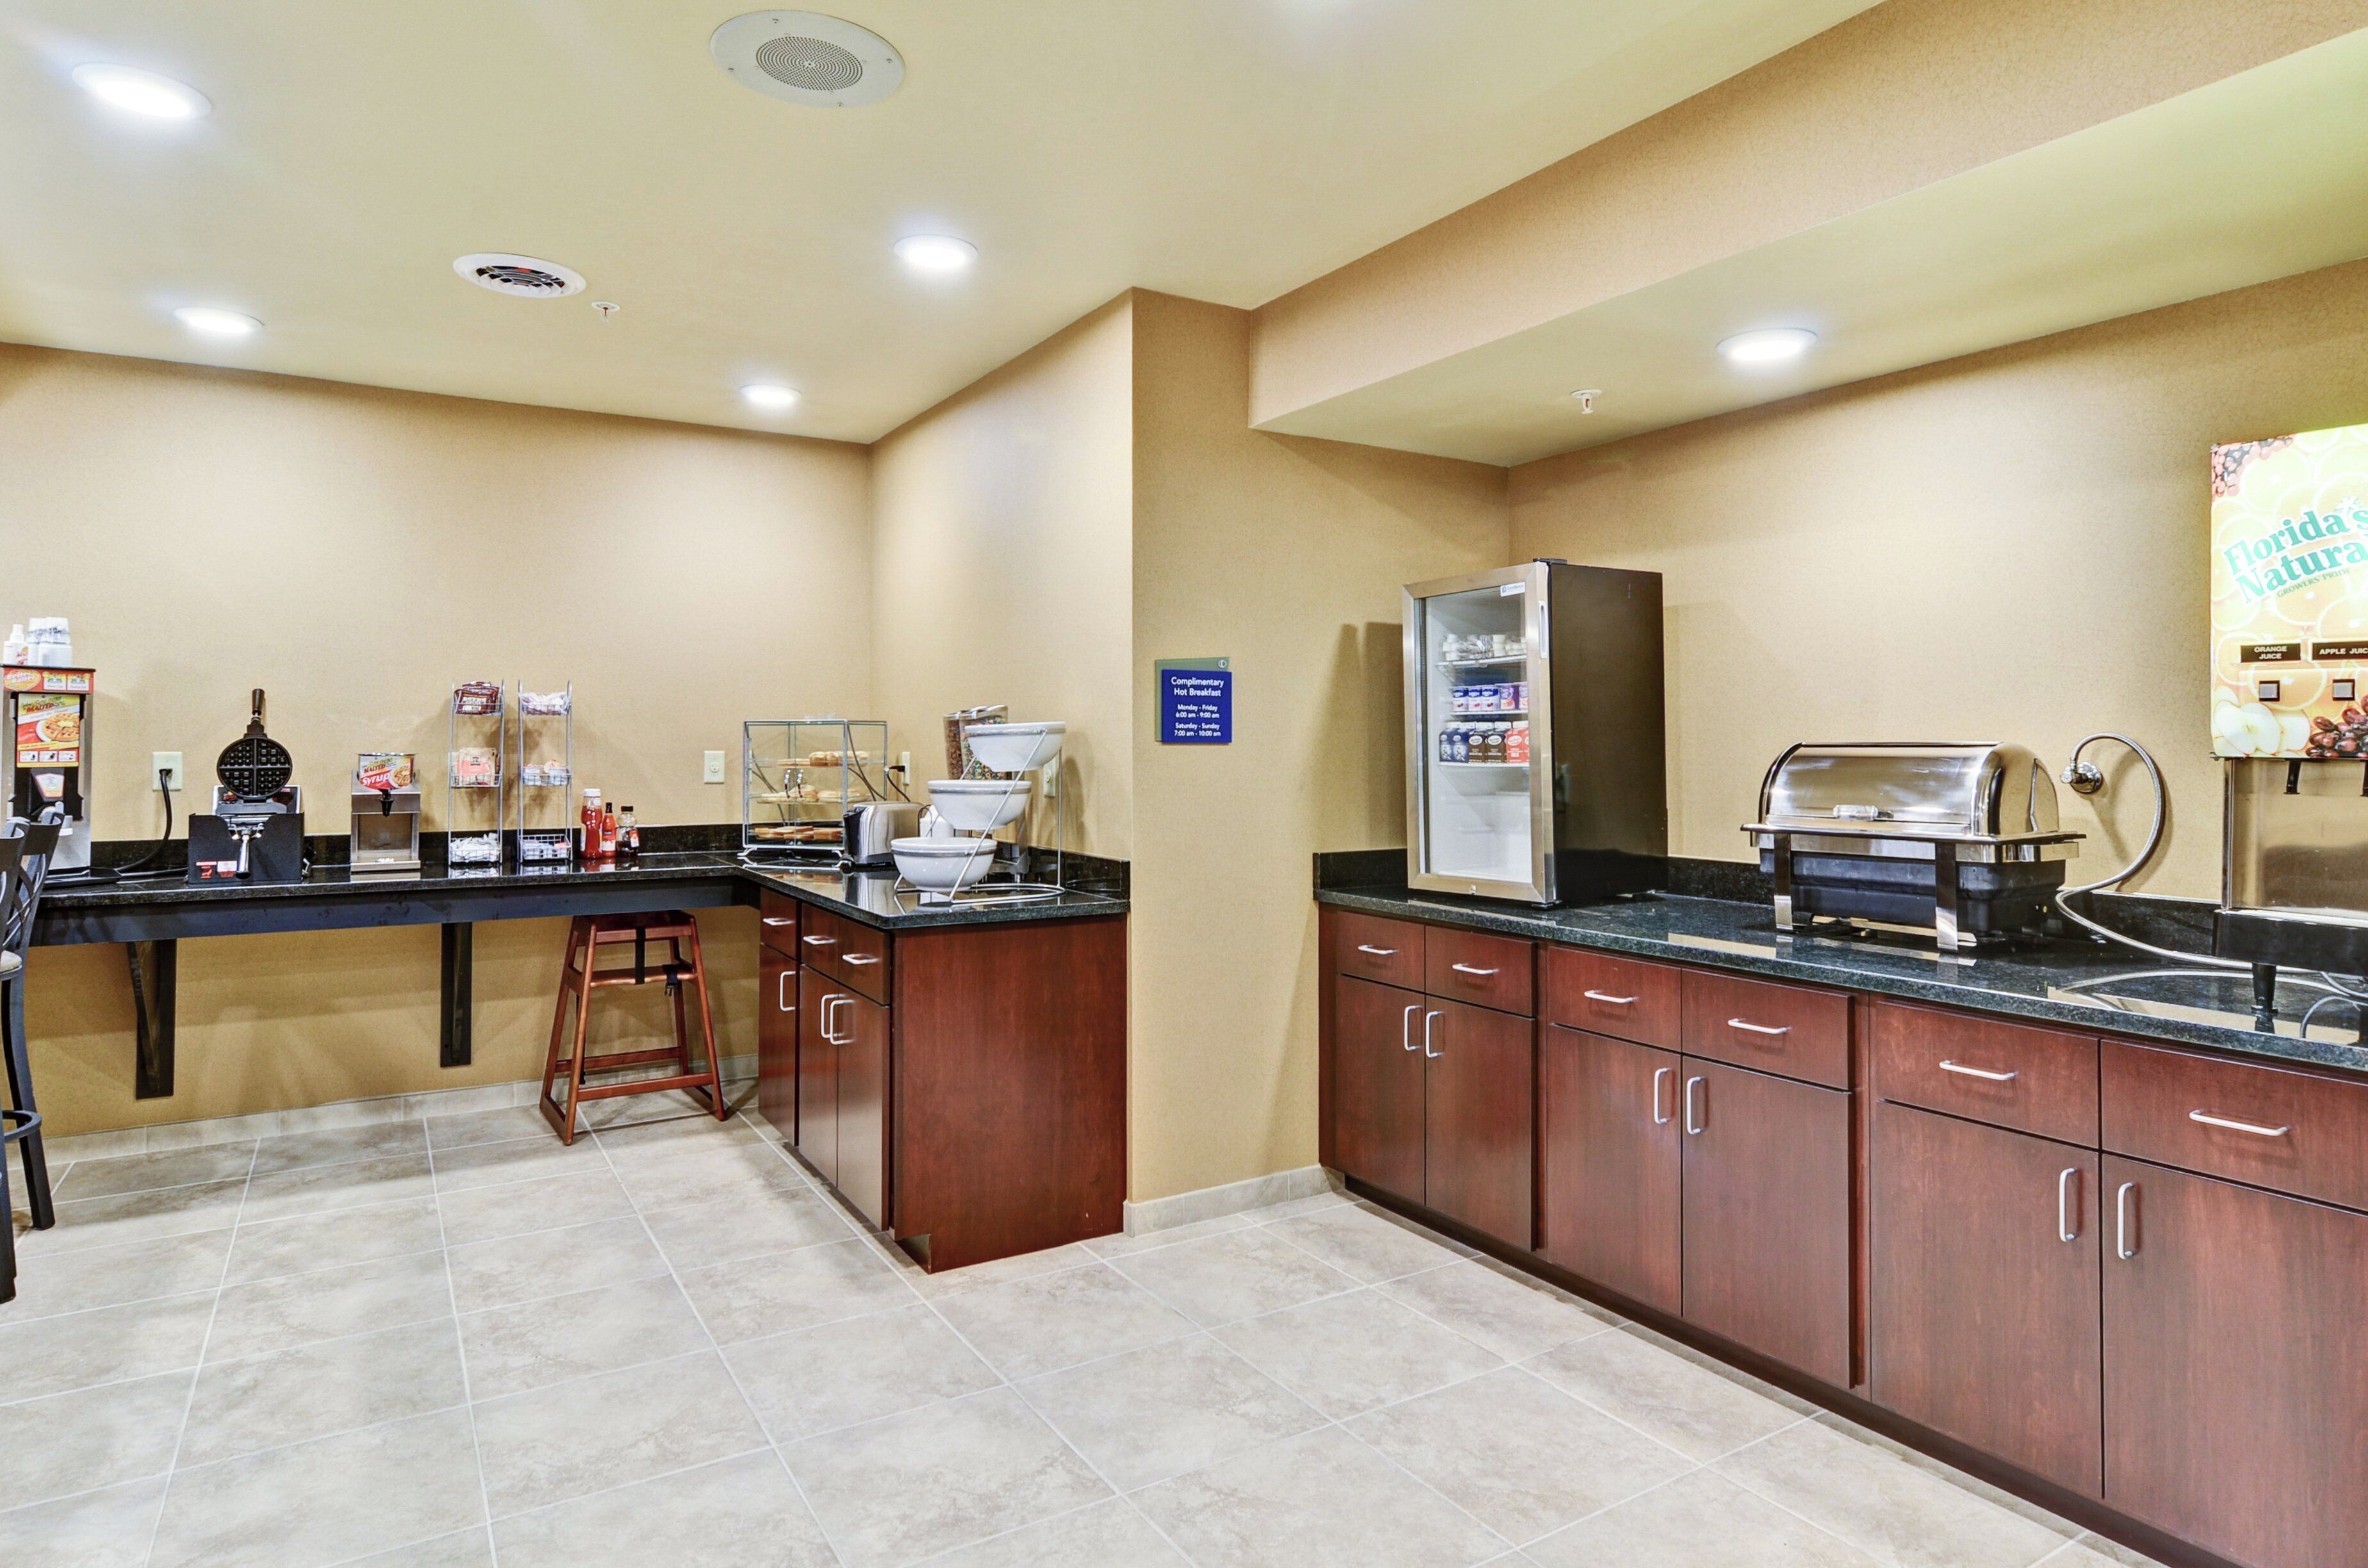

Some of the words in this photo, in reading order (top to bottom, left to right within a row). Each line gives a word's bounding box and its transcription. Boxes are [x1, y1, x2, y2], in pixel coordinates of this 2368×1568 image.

[2235, 542, 2368, 603] Natura
[1171, 676, 1224, 688] Complimentary
[1174, 687, 1187, 696] Hot
[1189, 687, 1221, 697] Breakfast
[1202, 704, 1218, 712] Friday
